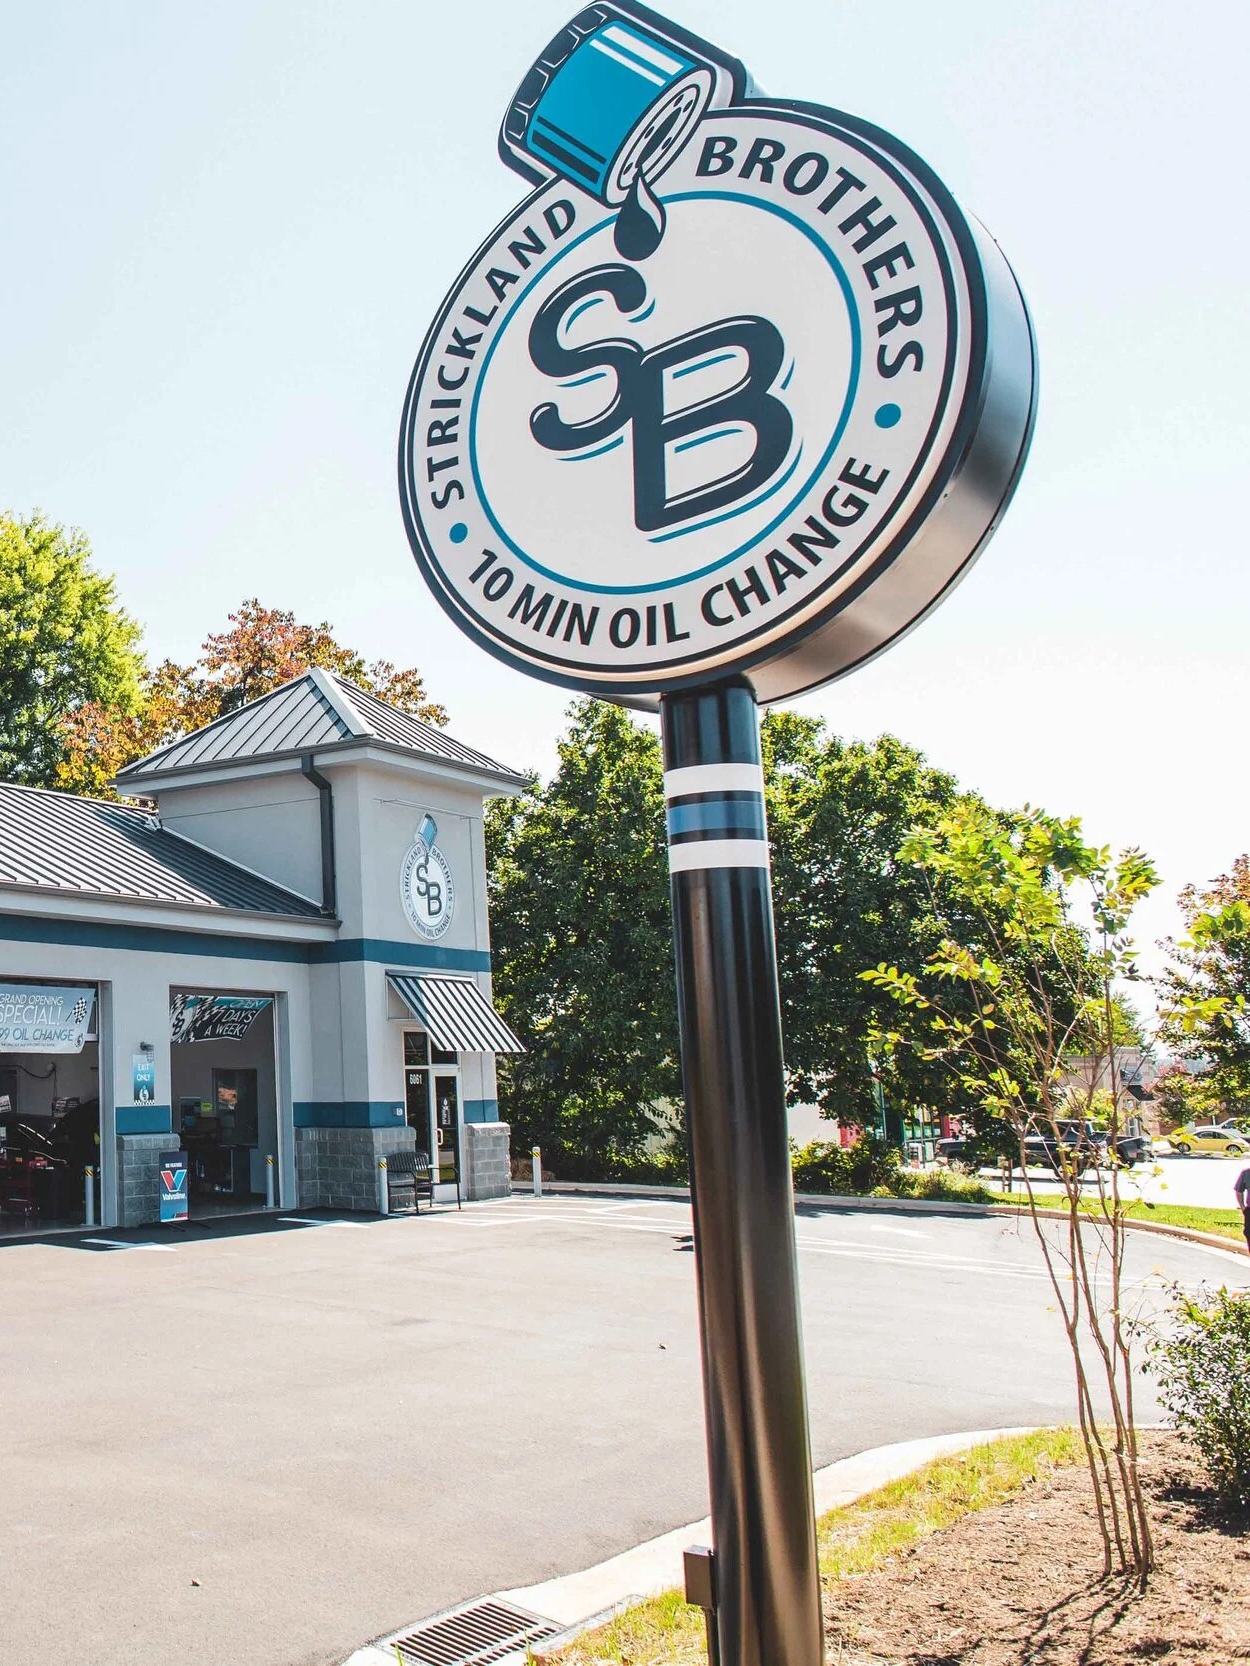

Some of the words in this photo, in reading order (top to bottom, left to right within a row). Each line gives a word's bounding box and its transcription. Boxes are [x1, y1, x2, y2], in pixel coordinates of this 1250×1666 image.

[427, 198, 577, 510] STRICKLAND
[696, 136, 924, 380] BROTHERS
[468, 548, 513, 604] 10
[507, 582, 599, 647] MIN
[609, 605, 690, 648] OIL
[700, 456, 890, 628] CHANGE
[405, 846, 422, 900] STRICKLAND
[431, 847, 453, 902] BROTHERS
[434, 914, 451, 937] CHANGE
[28, 994, 64, 1006] OPENING
[213, 1009, 225, 1022] 7
[222, 1009, 256, 1023] DAYS
[12, 1028, 29, 1041] OIL
[32, 1028, 75, 1042] CHANGE
[204, 1025, 212, 1036] A
[215, 1023, 248, 1037] WEEK!
